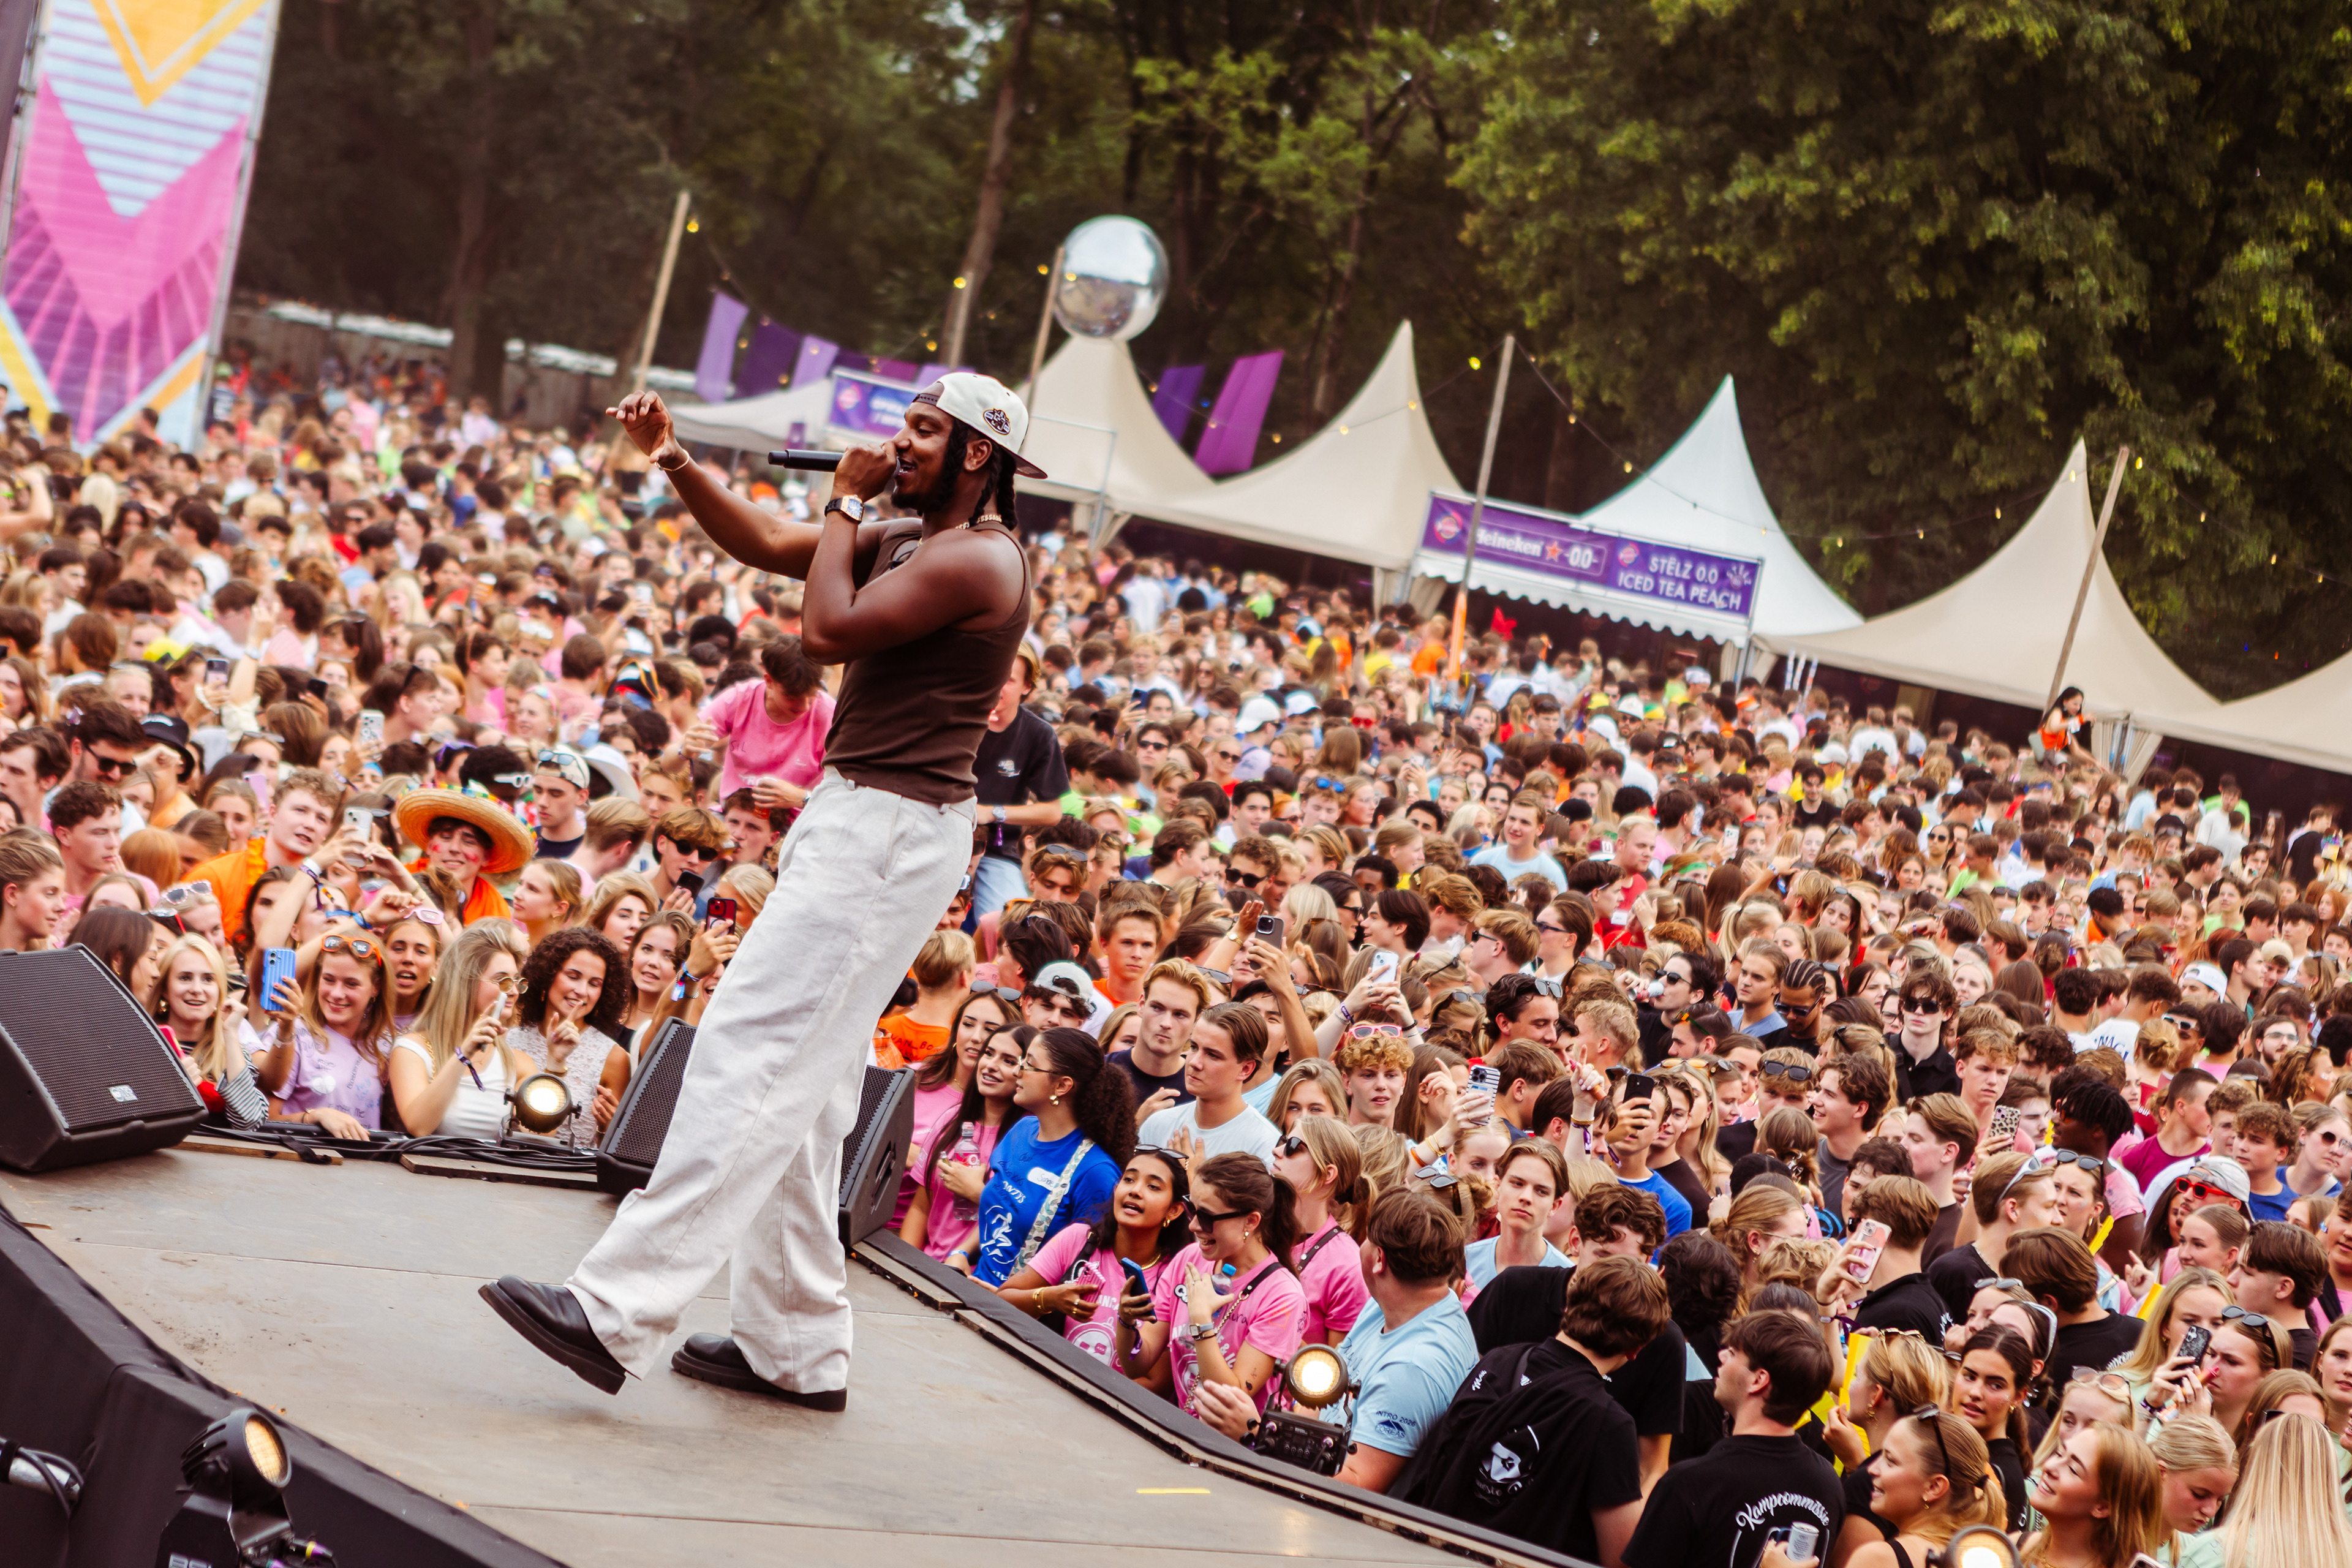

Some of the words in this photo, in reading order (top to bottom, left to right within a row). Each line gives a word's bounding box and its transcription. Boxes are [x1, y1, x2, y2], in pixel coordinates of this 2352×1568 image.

[1695, 565, 1719, 585] 0.0
[1618, 571, 1654, 593] ICED
[1659, 578, 1685, 600] TEA
[1689, 585, 1742, 611] PEACH
[1376, 1410, 1398, 1420] INTRO
[1399, 1417, 1416, 1427] 2026
[1735, 1491, 1830, 1531] Kampcommissie
